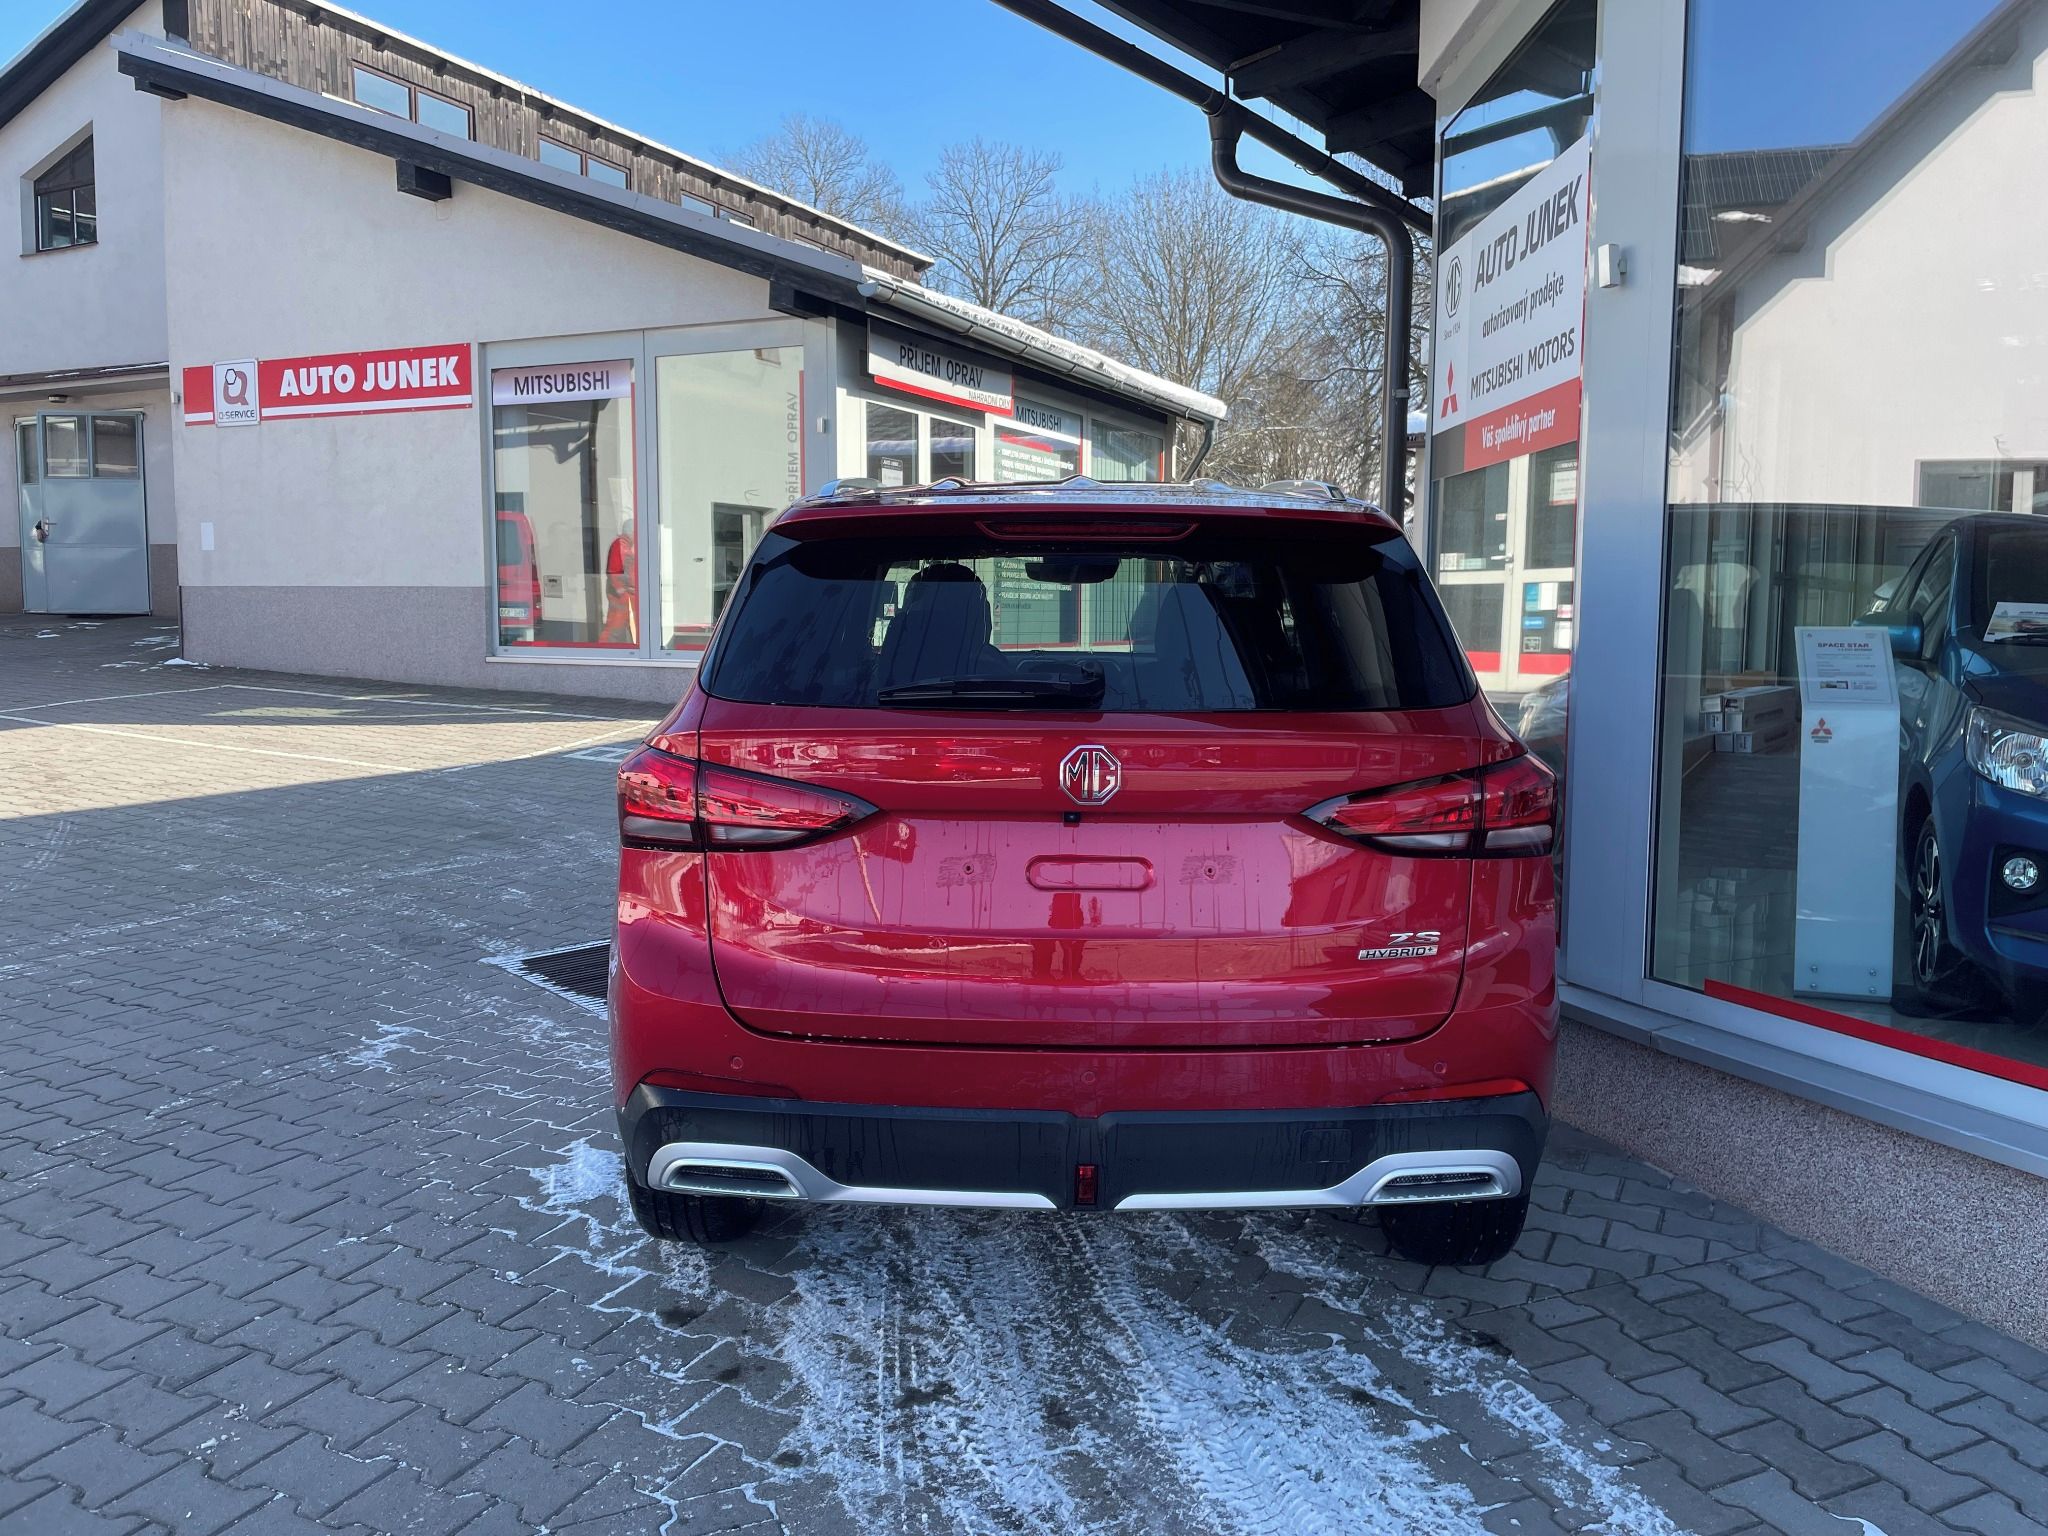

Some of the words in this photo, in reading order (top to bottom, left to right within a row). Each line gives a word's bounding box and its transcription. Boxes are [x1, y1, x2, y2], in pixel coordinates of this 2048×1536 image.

[1474, 225, 1518, 293] AUTO
[1519, 174, 1582, 262] JUNEK
[1446, 260, 1462, 314] MG
[1482, 289, 1528, 338] autorizovaný
[1529, 271, 1564, 320] prodejce
[279, 364, 356, 398] AUTO
[362, 355, 460, 391] JUNEK
[514, 370, 610, 396] MITSUBISHI
[899, 342, 941, 377] PŘÍJEM
[946, 359, 984, 388] OPRAV
[1470, 353, 1523, 400] MITSUBISHI
[1527, 328, 1575, 375] MOTORS
[786, 391, 798, 443] OPRAV
[1015, 405, 1062, 433] MITSUBISHI
[1481, 425, 1494, 448] Váš
[1495, 412, 1527, 451] spolehlivý
[1528, 408, 1556, 442] partner
[1065, 750, 1116, 799] MG
[1365, 947, 1433, 958] HYBRID+
[1387, 931, 1441, 946] ZS
